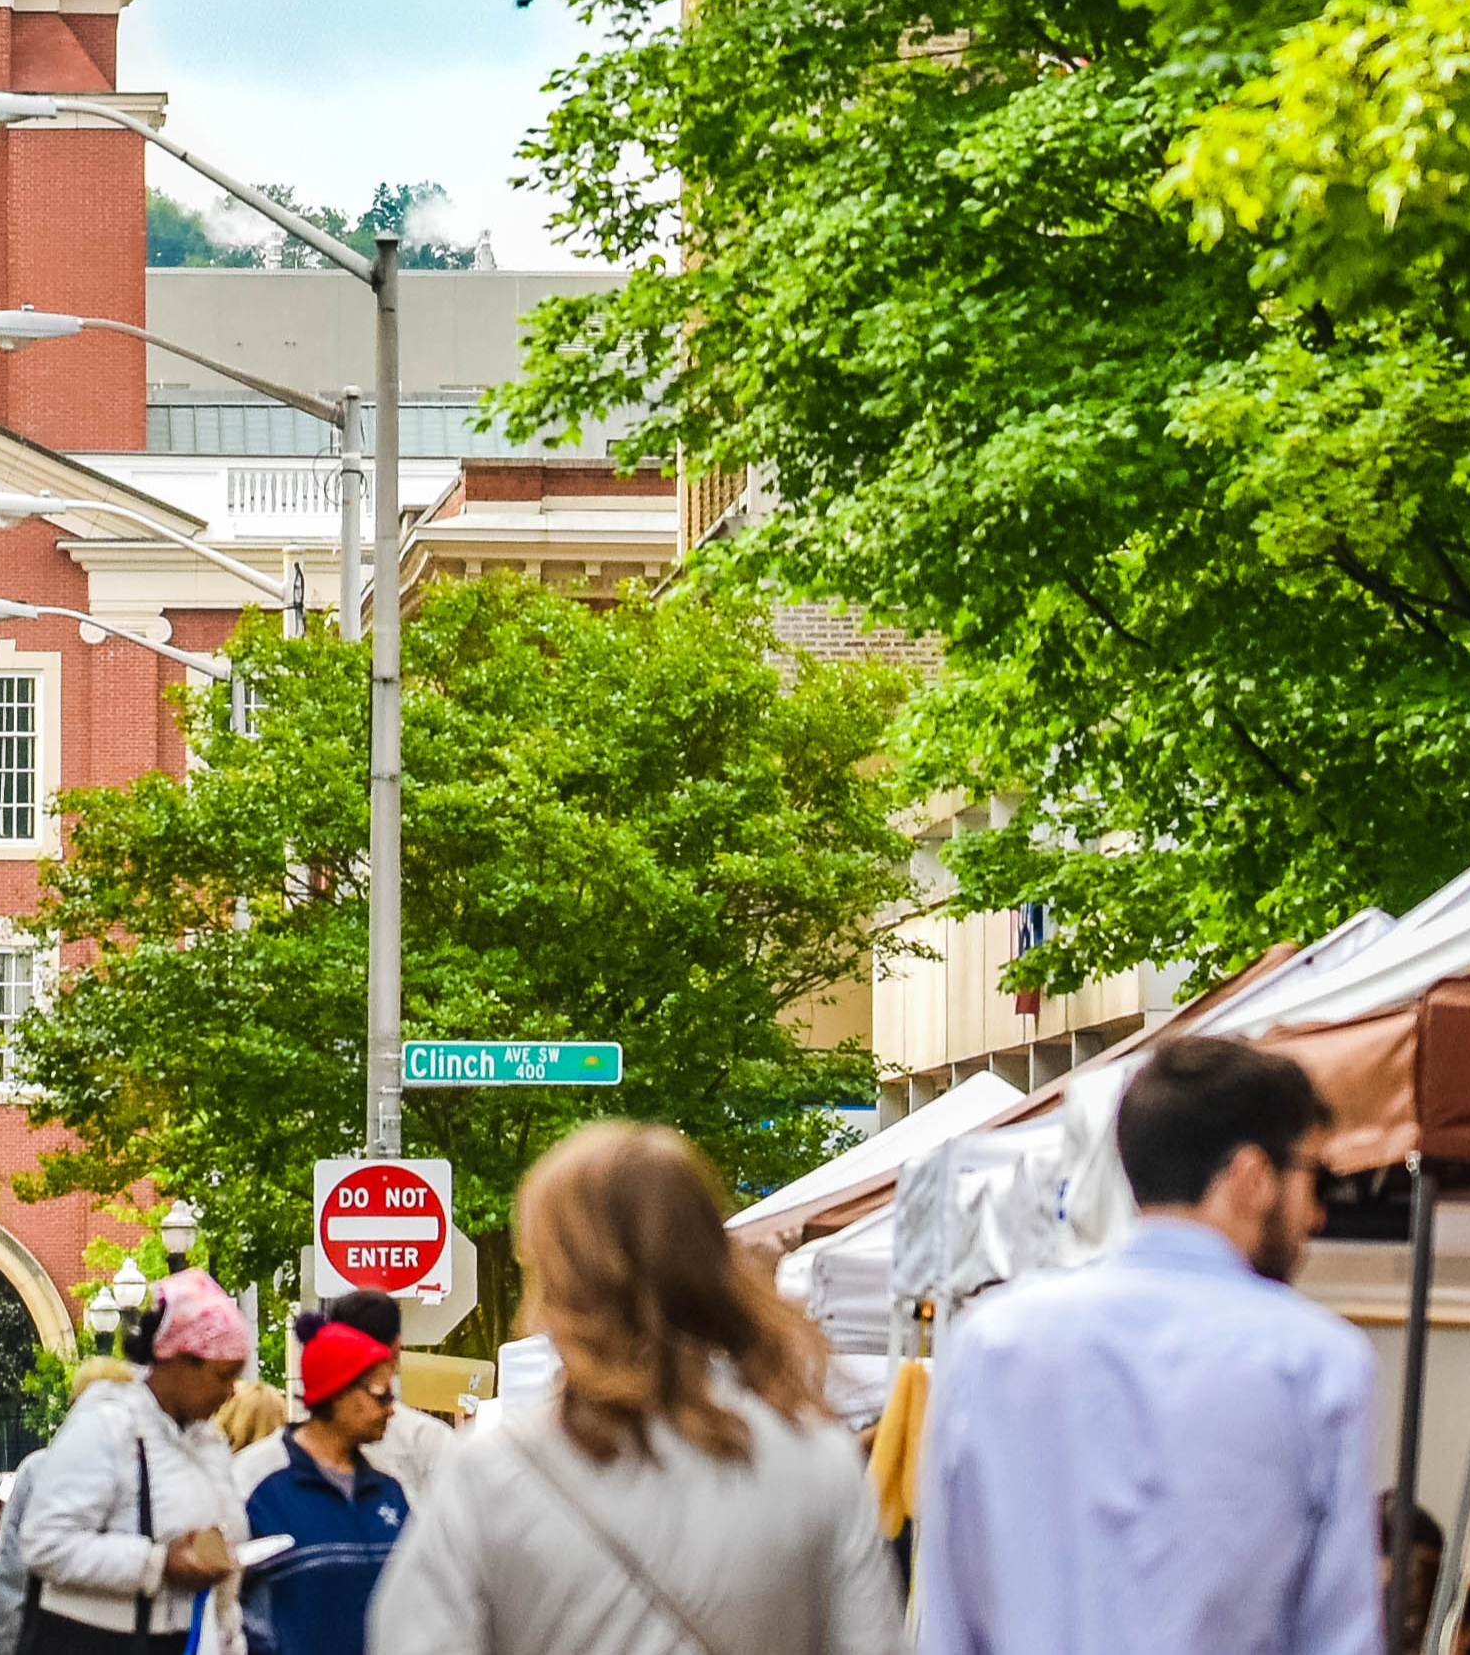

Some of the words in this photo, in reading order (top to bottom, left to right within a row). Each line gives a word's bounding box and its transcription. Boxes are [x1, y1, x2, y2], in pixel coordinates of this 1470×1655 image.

[410, 1047, 496, 1079] Clinch
[504, 1047, 531, 1063] AVE
[538, 1047, 560, 1063] SW
[515, 1063, 546, 1079] 400
[338, 1187, 370, 1208] DO
[385, 1187, 428, 1208] NOT
[347, 1247, 419, 1268] ENTER
